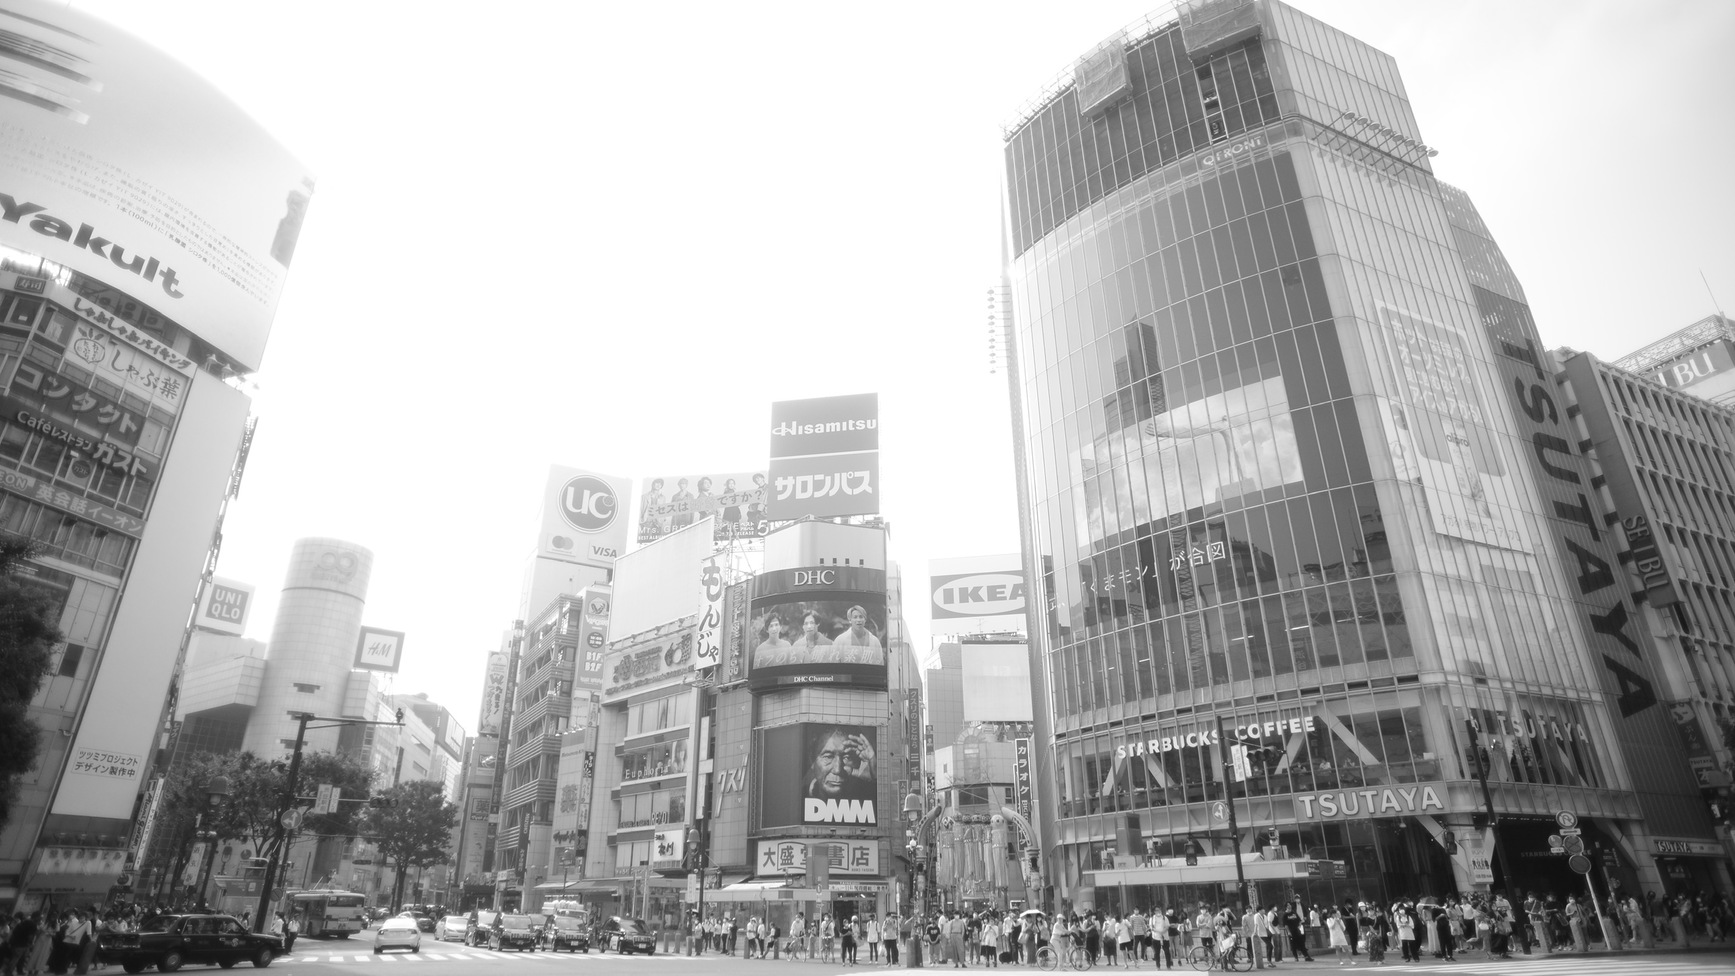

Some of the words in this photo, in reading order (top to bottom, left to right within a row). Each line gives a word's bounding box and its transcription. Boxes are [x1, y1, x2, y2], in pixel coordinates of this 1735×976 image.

[1203, 136, 1264, 166] QFRONT
[0, 193, 184, 299] Yakult
[74, 297, 191, 369] しゃぶしゃぶバイキング
[111, 349, 180, 400] しゃぶ葉
[16, 363, 137, 434] コンタクト
[772, 418, 877, 436] Hisamitsu
[93, 442, 147, 476] ガスト
[775, 470, 872, 501] サロンパス
[566, 486, 614, 519] UC
[647, 502, 690, 517] ミセスは
[757, 519, 769, 536] 5
[1502, 338, 1657, 717] TSUTAYA
[592, 545, 618, 559] VISA
[1624, 514, 1668, 591] SEIBU
[794, 570, 836, 586] DHC
[215, 588, 241, 605] UNI
[942, 582, 1025, 605] IKEA
[210, 603, 240, 620] QLO
[697, 557, 723, 662] もんじゃ
[367, 641, 391, 658] H&M
[809, 675, 834, 683] Channel
[1117, 730, 1219, 759] STARBUCKS
[1235, 716, 1316, 741] COFFEE
[1497, 714, 1590, 744] TSUTAYA
[74, 761, 136, 778] デザイン製作中
[79, 751, 138, 767] ツツミプロジェクト
[1018, 746, 1030, 794] カラオケ
[804, 797, 876, 823] DMM
[1299, 786, 1443, 818] TSUTAYA
[1655, 839, 1693, 854] TSUTAYA
